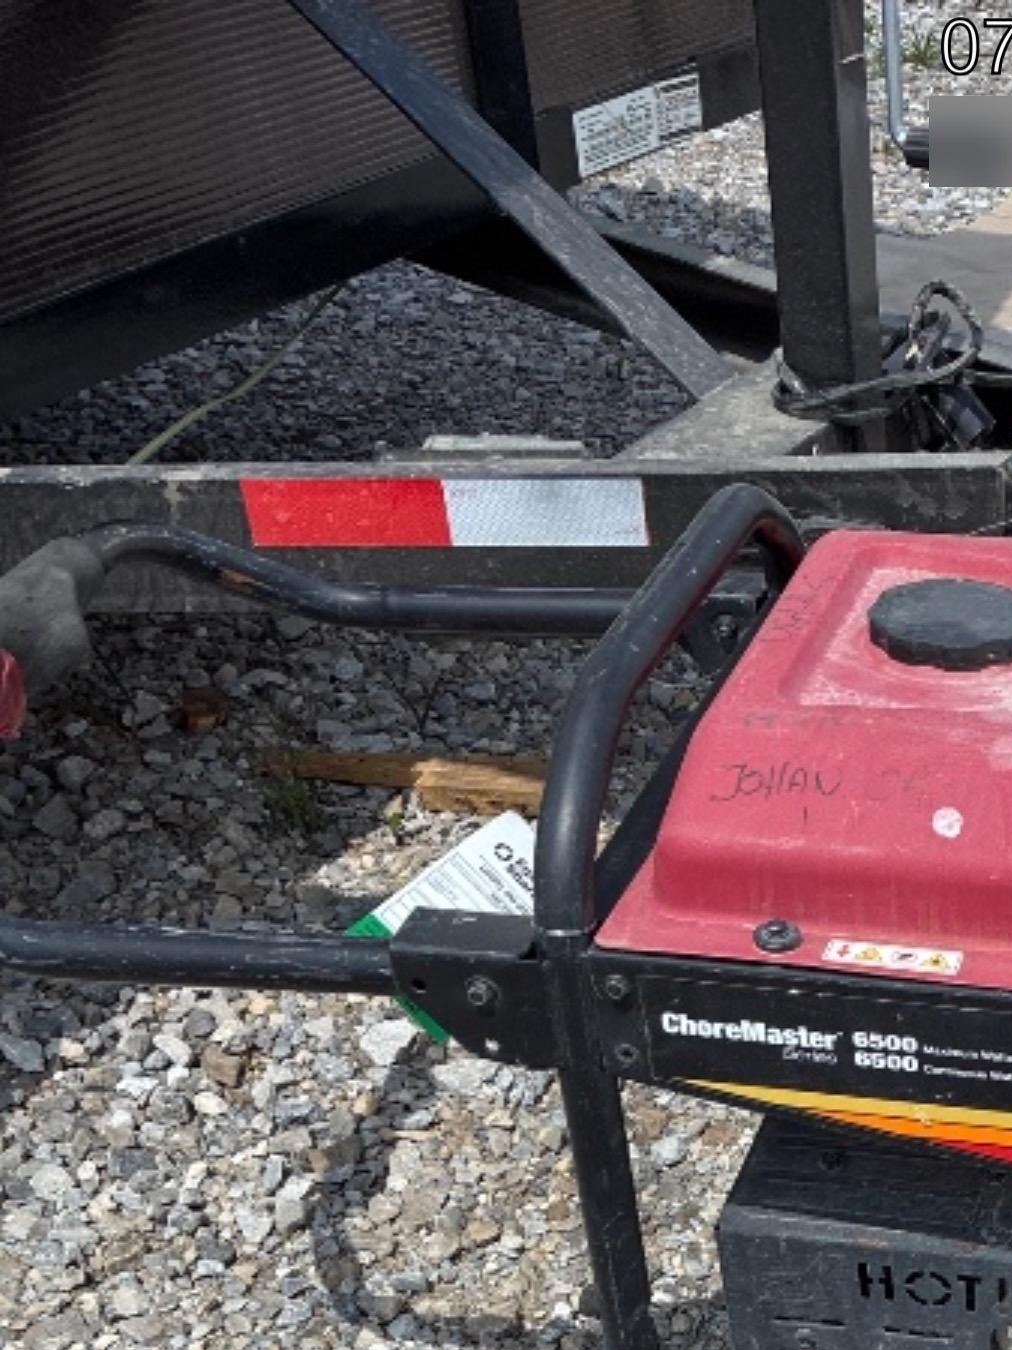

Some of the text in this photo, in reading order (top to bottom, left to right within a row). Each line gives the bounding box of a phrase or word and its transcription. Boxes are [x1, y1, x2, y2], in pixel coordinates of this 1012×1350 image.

[661, 1010, 838, 1051] ChoreMaster
[852, 1030, 918, 1053] 6500
[854, 1051, 920, 1073] 6500
